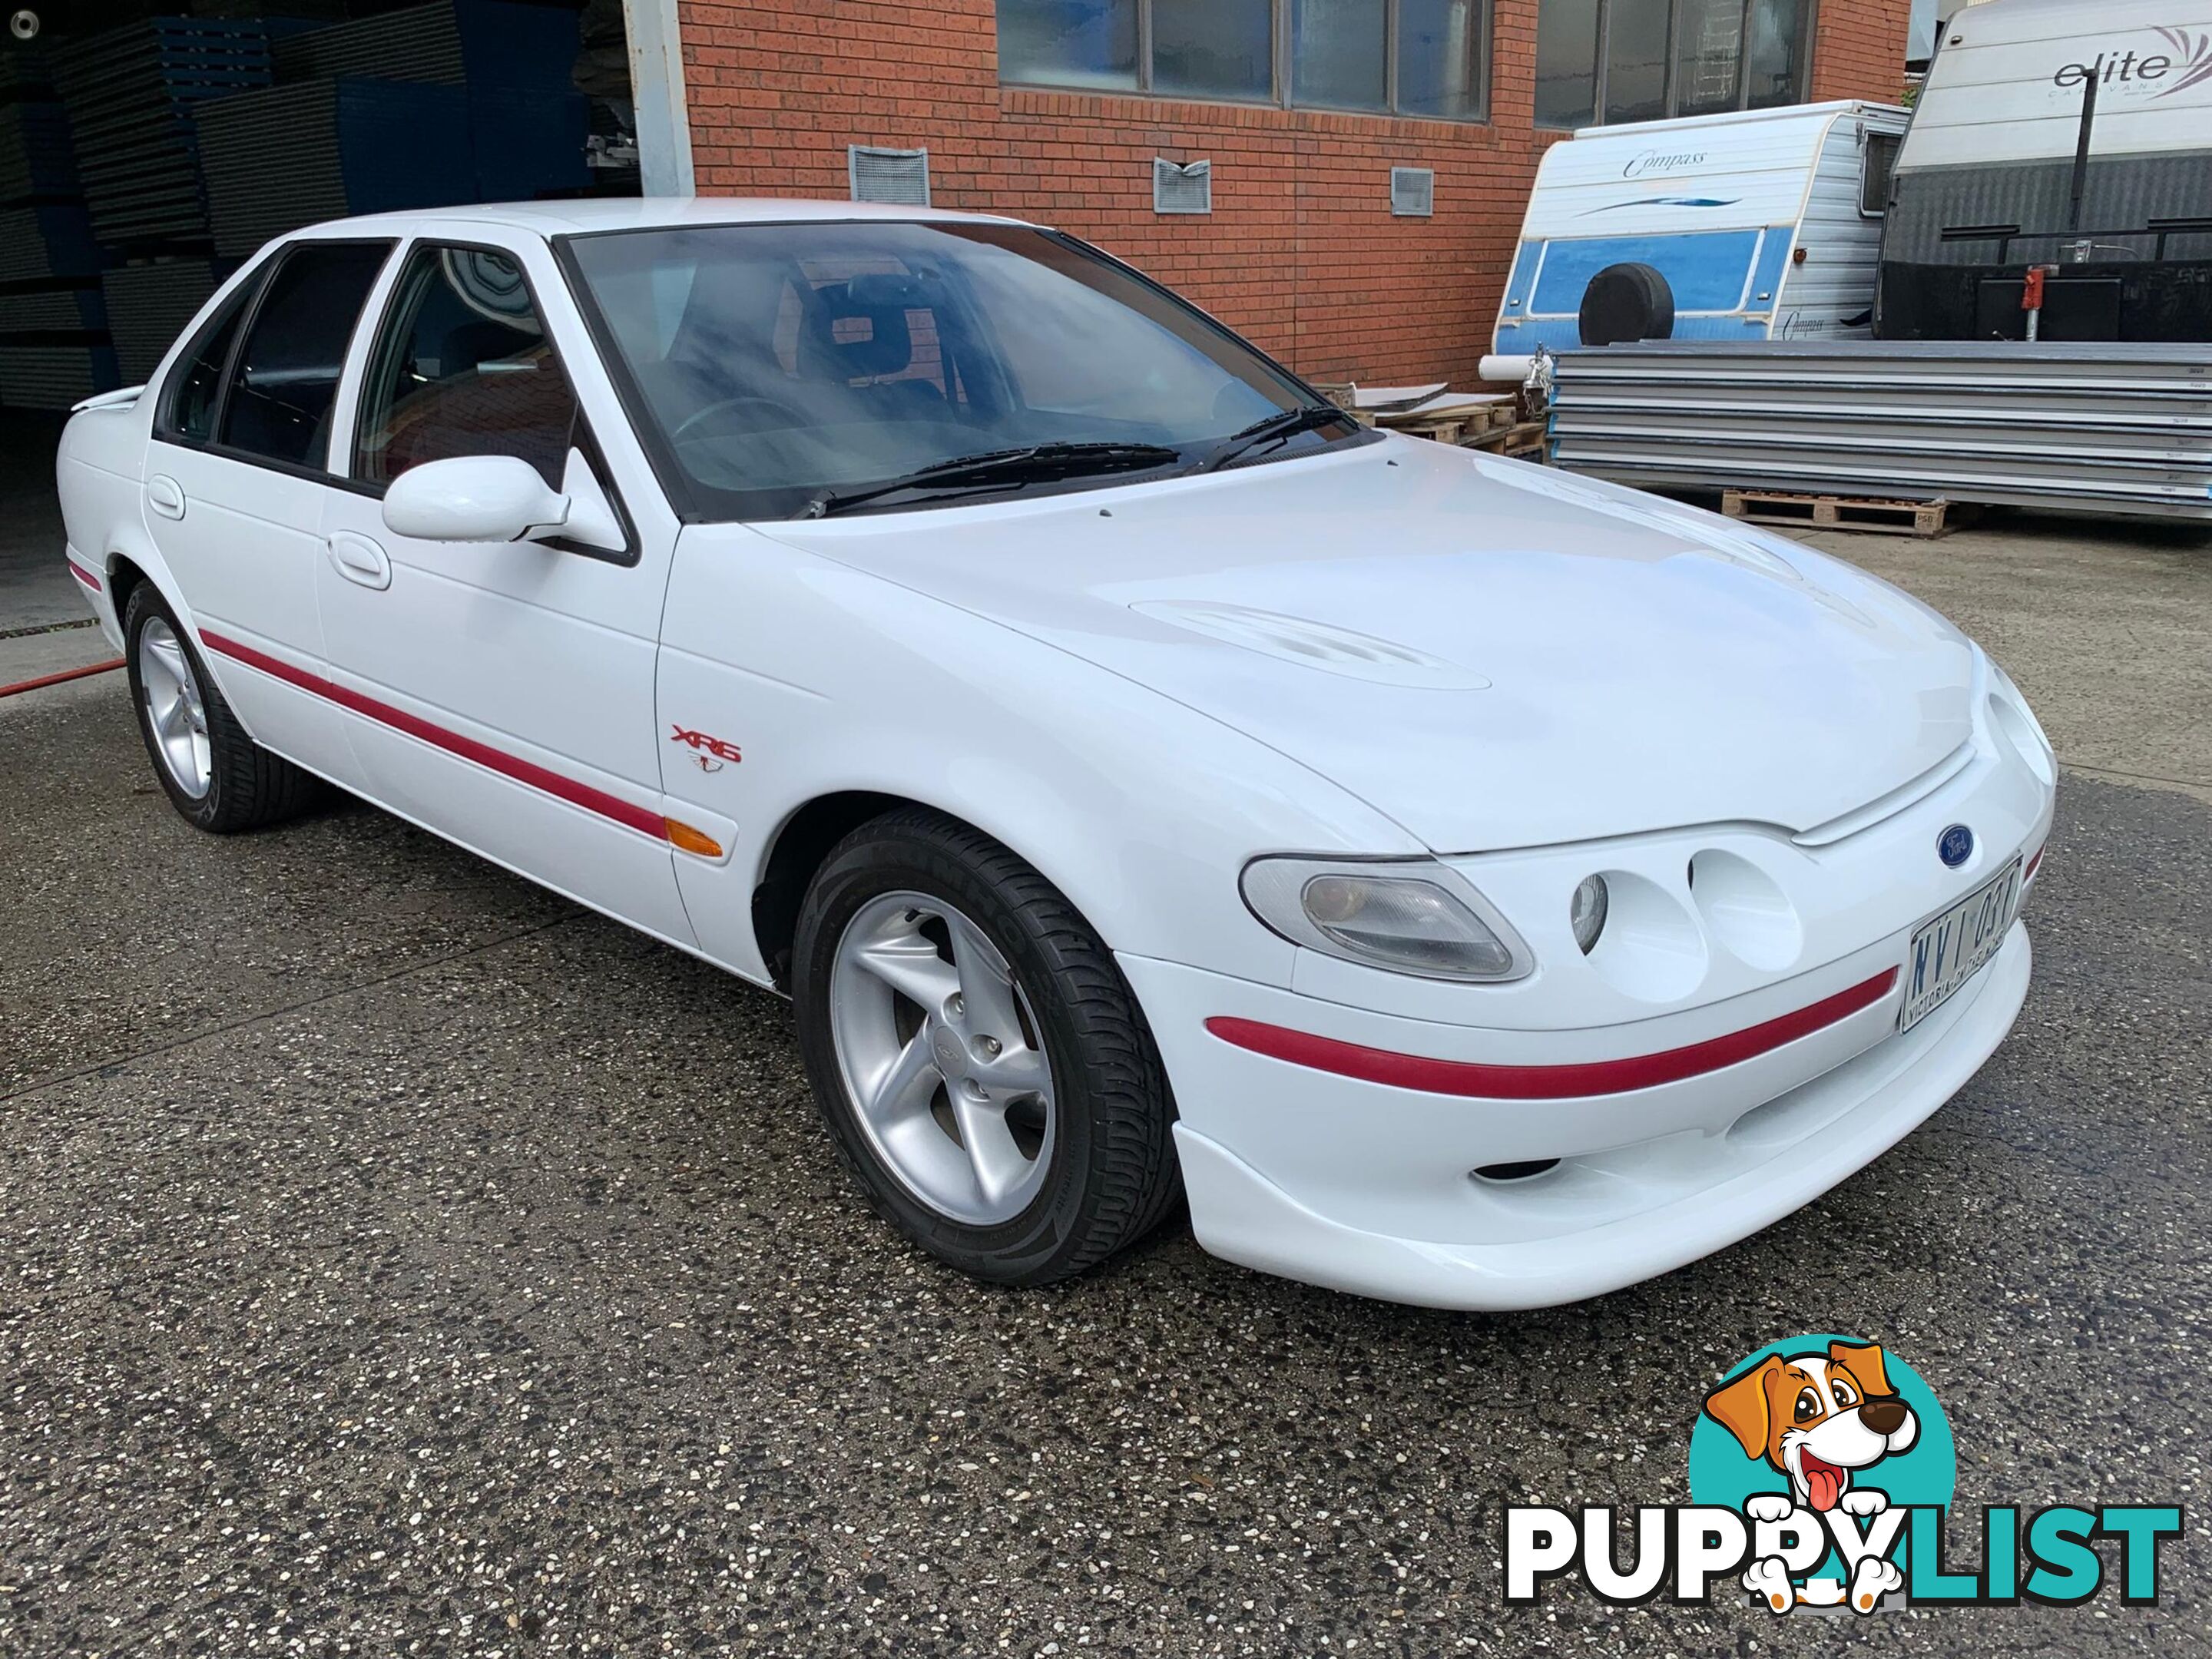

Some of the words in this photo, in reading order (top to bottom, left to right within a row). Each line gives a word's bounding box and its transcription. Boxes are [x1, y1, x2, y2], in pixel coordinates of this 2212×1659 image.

[2054, 51, 2171, 88] elite
[1623, 150, 1707, 177] Compass
[671, 724, 742, 763] XR6
[1946, 833, 1968, 858] Ford
